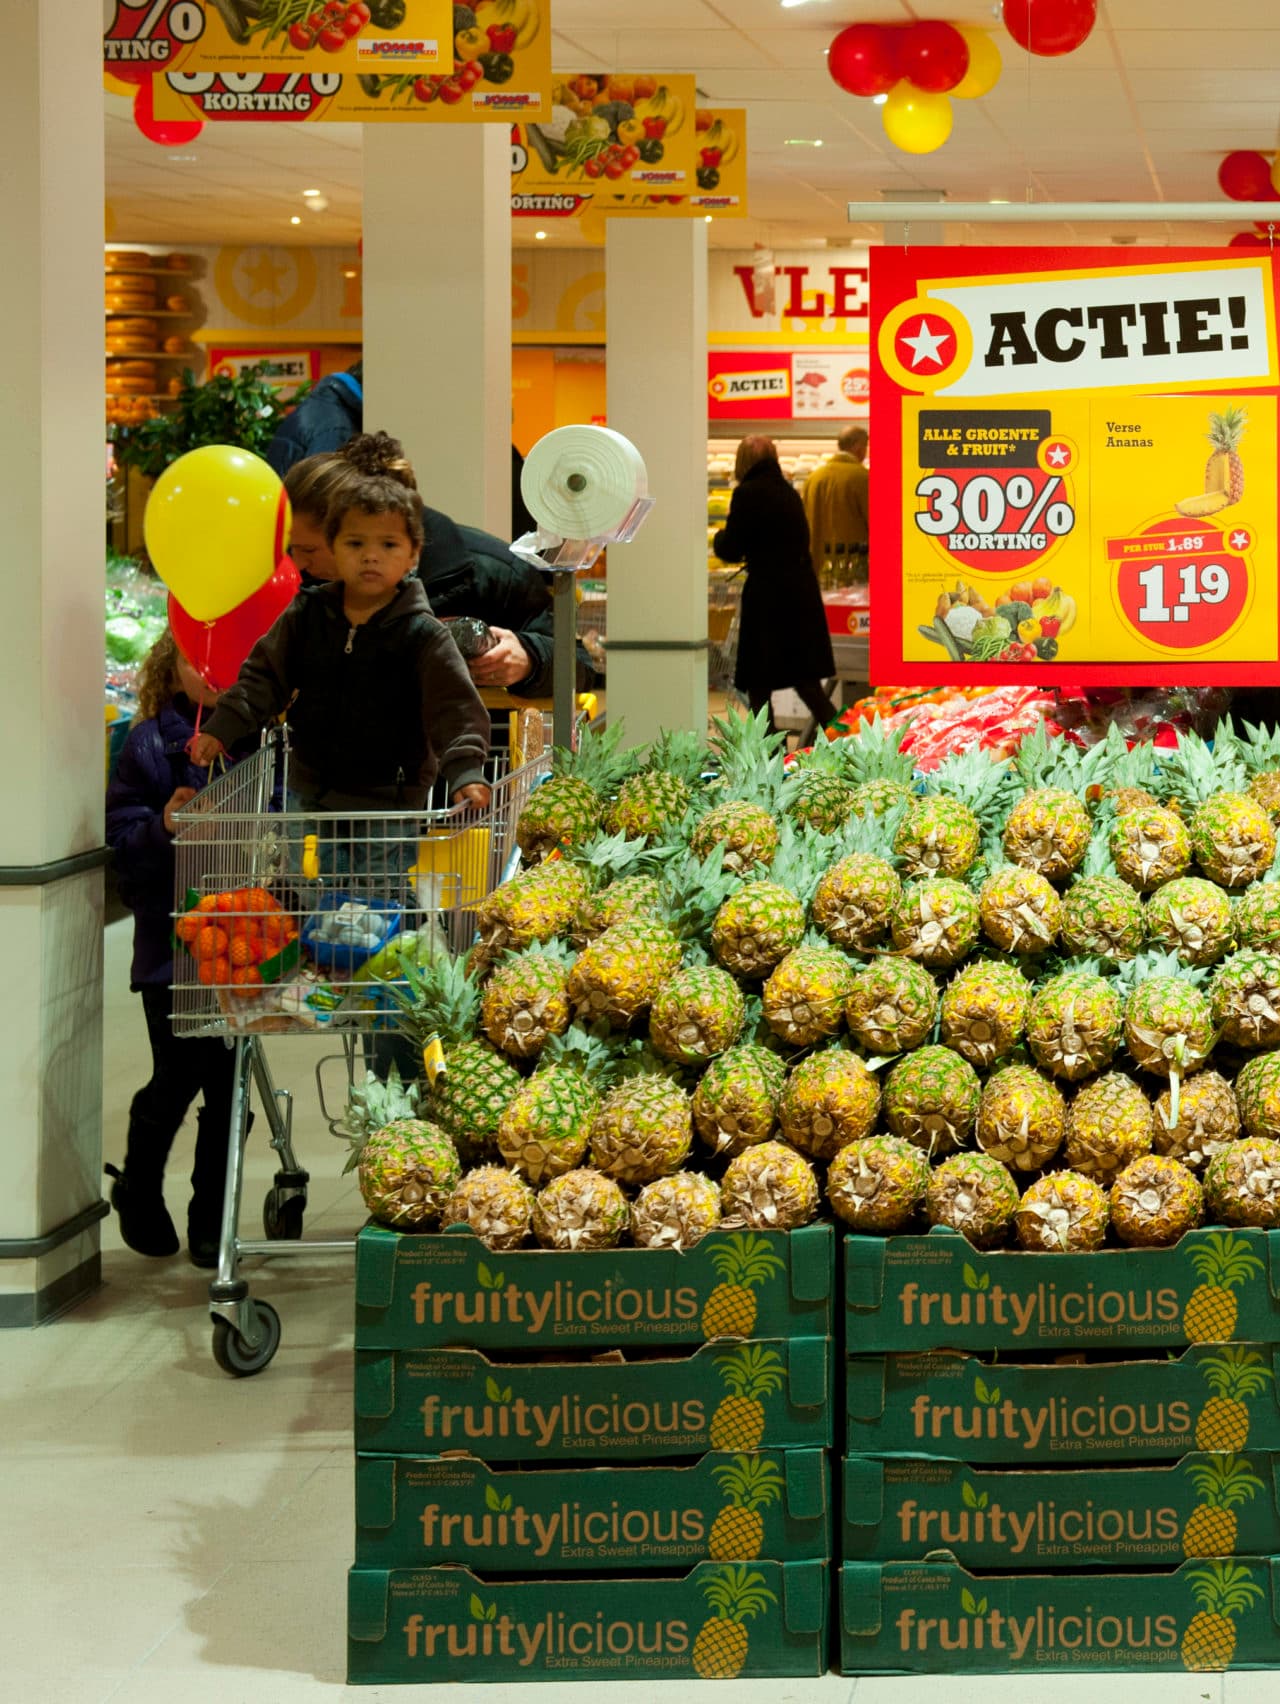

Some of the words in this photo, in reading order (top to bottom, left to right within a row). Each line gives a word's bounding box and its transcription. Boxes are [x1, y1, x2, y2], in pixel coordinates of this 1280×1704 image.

[104, 39, 169, 60] TING
[203, 92, 311, 111] KORTING
[512, 195, 575, 210] ORTING
[733, 267, 868, 317] VLE
[984, 296, 1250, 368] ACTIE!
[730, 378, 784, 392] ACTIE!
[923, 429, 962, 441] ALLE
[965, 429, 1039, 441] GROENTE
[1106, 422, 1141, 433] Verse
[946, 444, 959, 456] &
[1105, 436, 1154, 448] Ananas
[914, 474, 1075, 535] 30%
[948, 533, 1047, 550] KORTING
[1124, 544, 1142, 553] PER
[1138, 564, 1230, 622] 1.19
[411, 1280, 698, 1333] fruitylicious
[899, 1283, 1180, 1336] fruitylicious
[553, 1323, 587, 1335] Extra
[590, 1322, 631, 1335] Sweet
[634, 1320, 698, 1335] Pineapple
[1038, 1325, 1071, 1337] Extra
[1073, 1324, 1114, 1336] Sweet
[1117, 1322, 1180, 1336] Pineapple
[419, 1394, 706, 1448] fruitylicious
[910, 1395, 1191, 1449] fruitylicious
[561, 1436, 596, 1448] Extra
[599, 1435, 640, 1447] Sweet
[643, 1433, 706, 1447] Pineapple
[1049, 1439, 1082, 1451] Extra
[1085, 1437, 1125, 1449] Sweet
[1128, 1435, 1192, 1449] Pineapple
[419, 1501, 705, 1558] fruitylicious
[897, 1500, 1178, 1554] fruitylicious
[561, 1546, 595, 1558] Extra
[597, 1545, 638, 1557] Sweet
[641, 1543, 705, 1557] Pineapple
[1036, 1543, 1070, 1555] Extra
[1072, 1542, 1113, 1554] Sweet
[1116, 1541, 1180, 1554] Pineapple
[402, 1612, 689, 1667] fruitylicious
[896, 1606, 1178, 1660] fruitylicious
[545, 1656, 579, 1669] Extra
[582, 1655, 623, 1667] Sweet
[626, 1653, 690, 1667] Pineapple
[1035, 1649, 1069, 1662] Extra
[1071, 1649, 1112, 1661] Sweet
[1114, 1647, 1178, 1661] Pineapple
